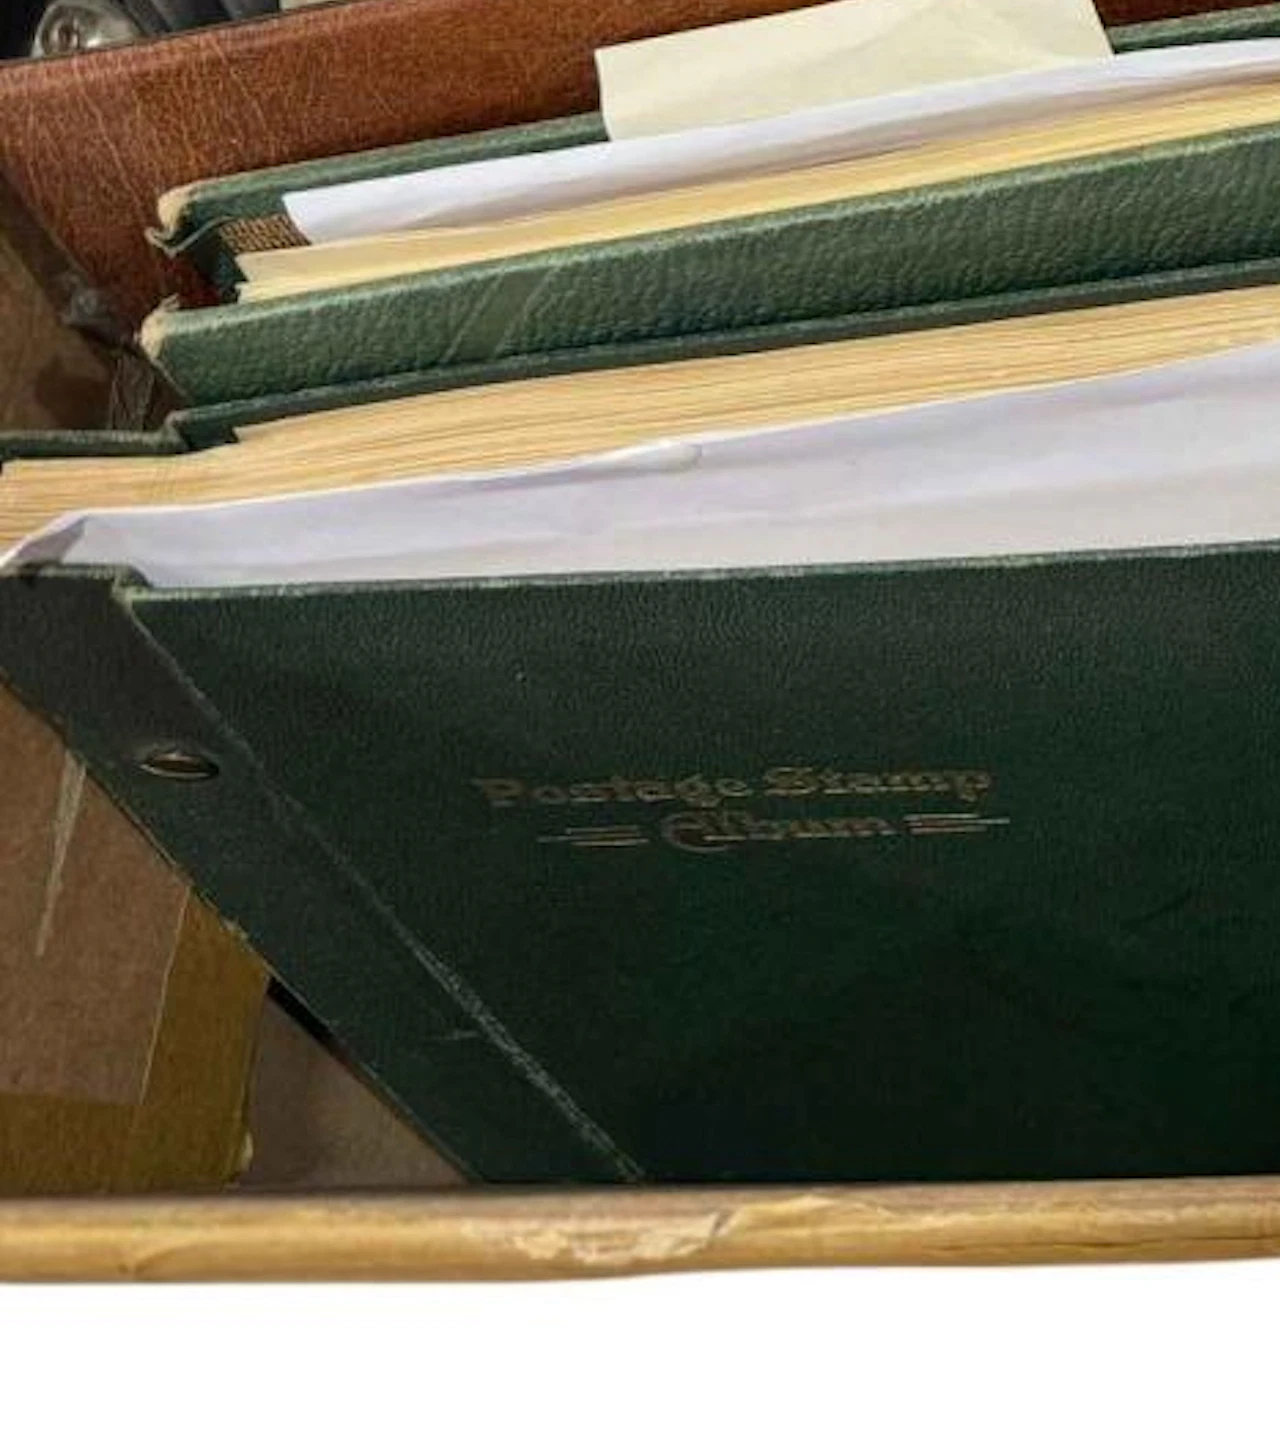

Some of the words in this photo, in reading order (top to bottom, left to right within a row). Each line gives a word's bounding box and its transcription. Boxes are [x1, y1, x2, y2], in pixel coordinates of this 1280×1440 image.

[472, 772, 752, 807] Postage
[763, 766, 992, 802] Stamp
[660, 810, 898, 853] Album
